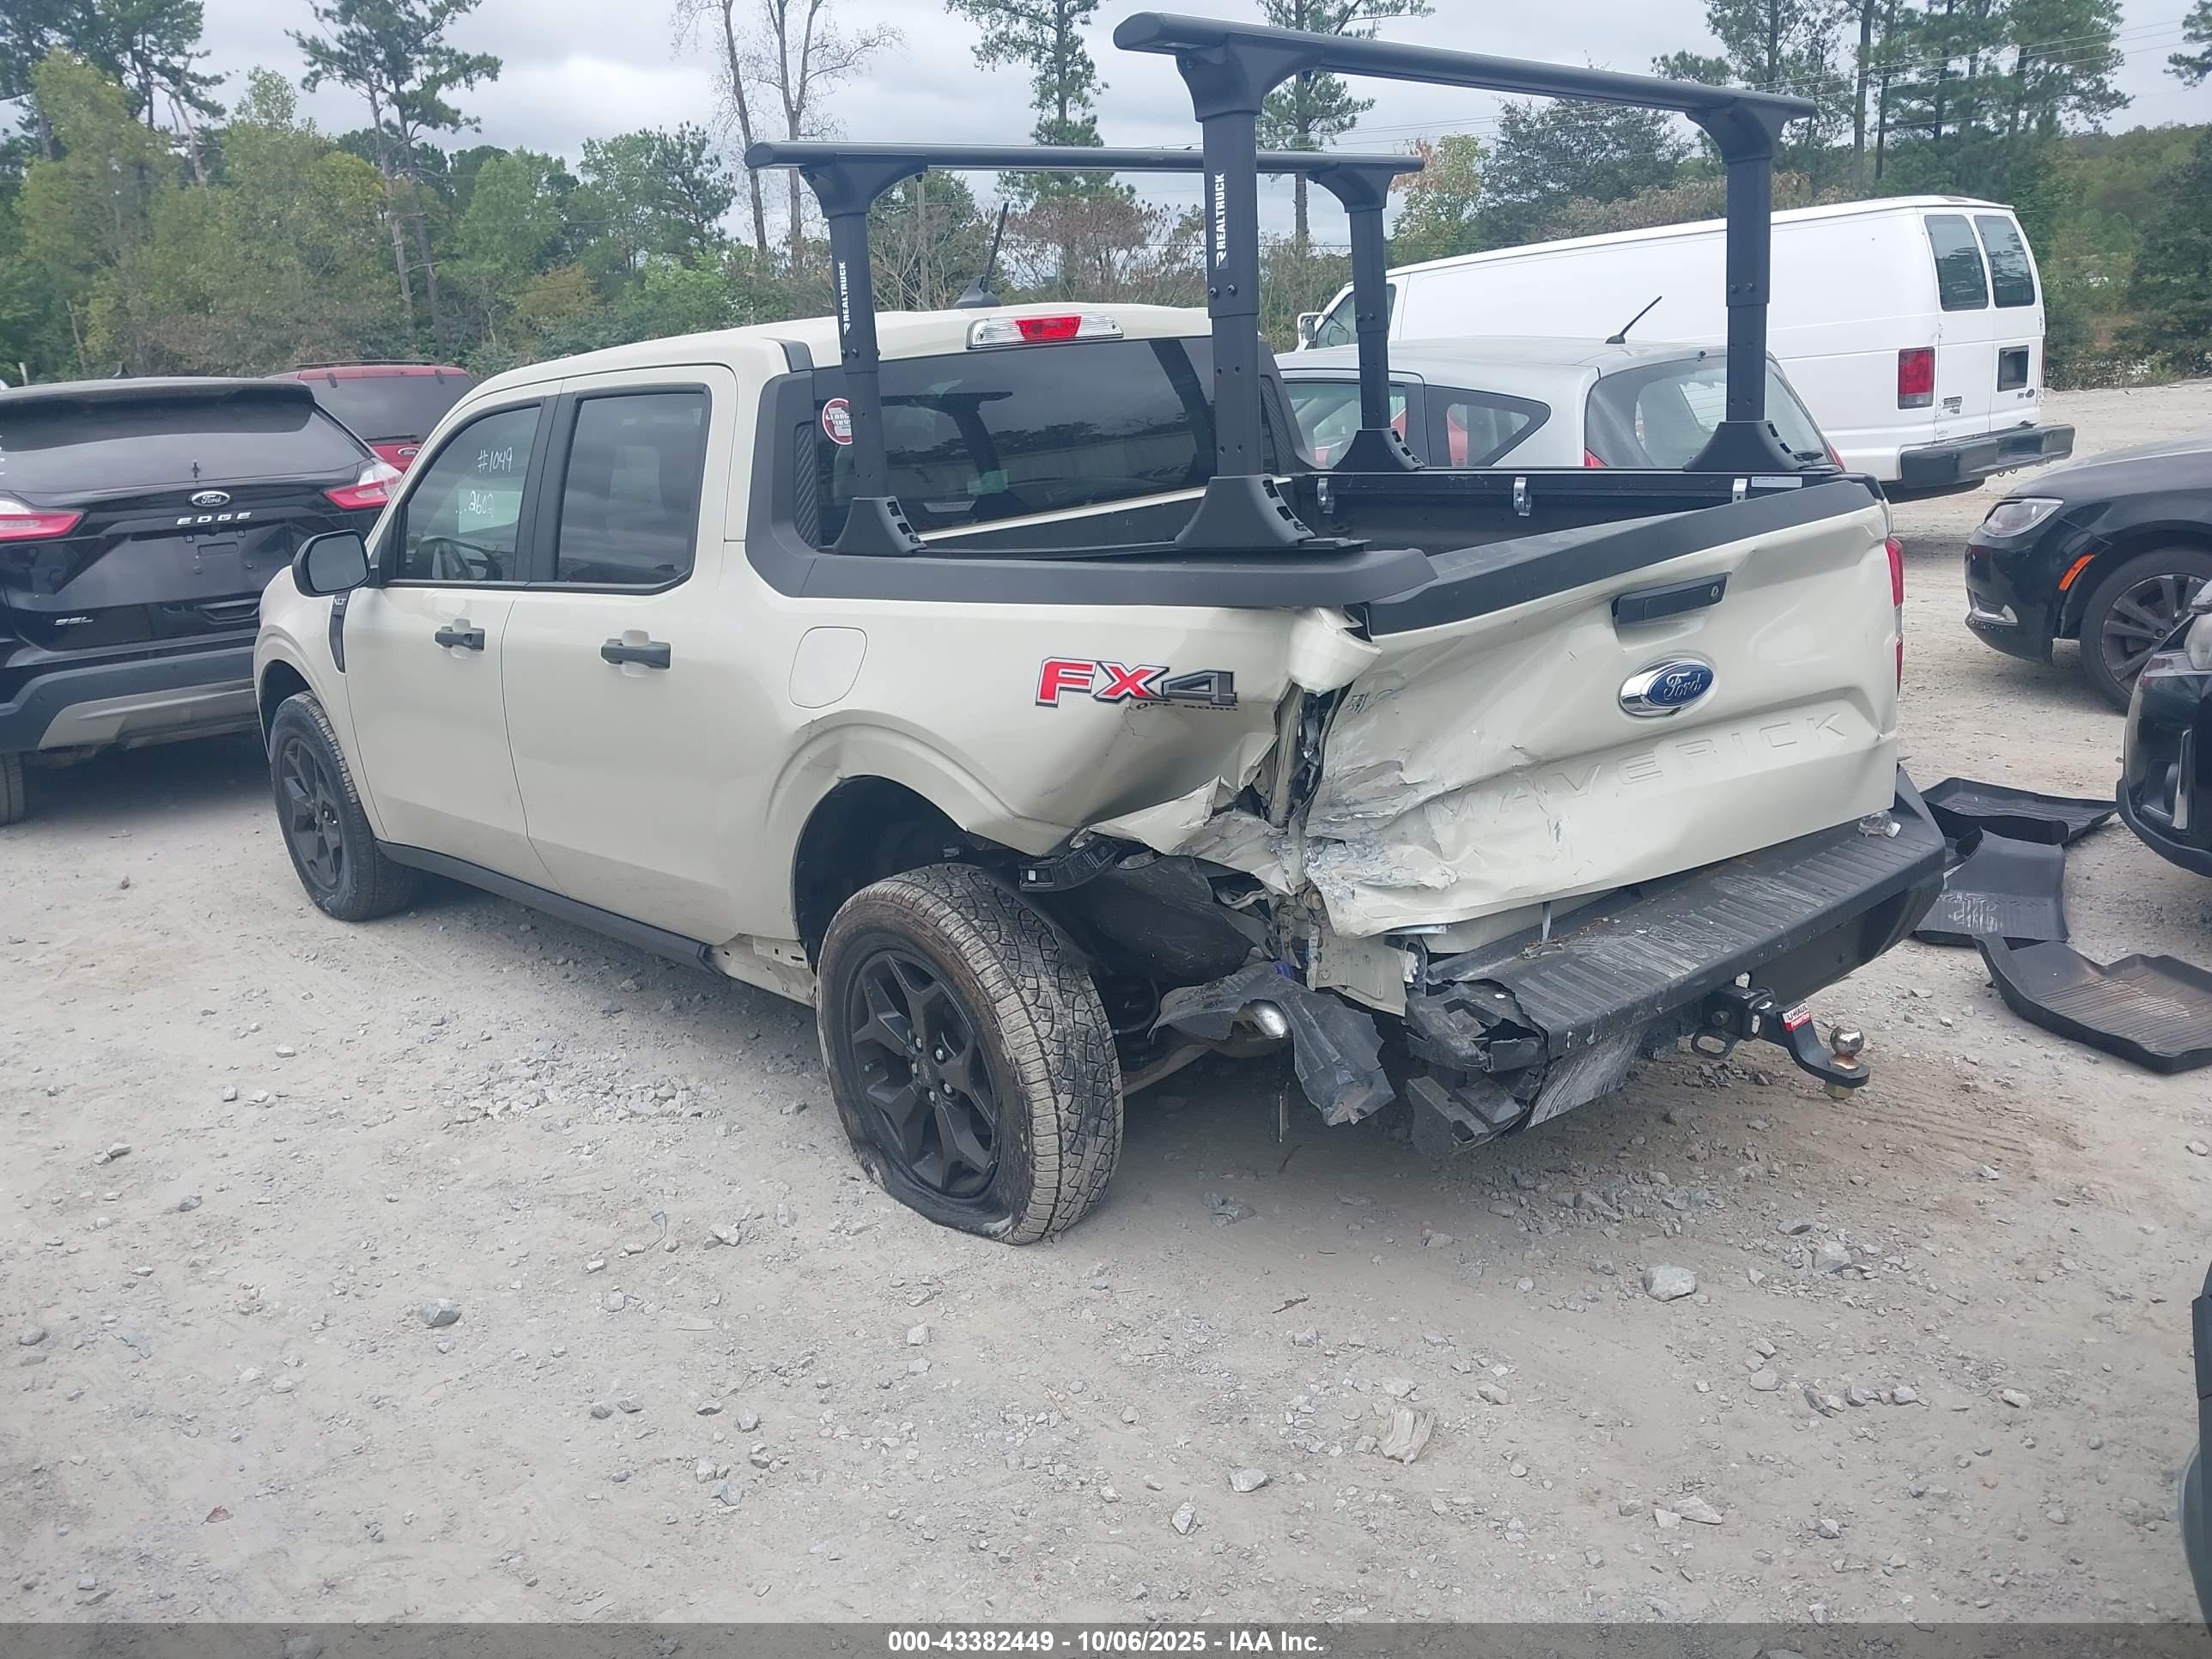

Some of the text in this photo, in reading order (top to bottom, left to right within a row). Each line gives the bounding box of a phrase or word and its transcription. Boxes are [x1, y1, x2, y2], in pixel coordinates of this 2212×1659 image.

[1214, 173, 1226, 250] REALTRUCK
[838, 261, 850, 321] REALTRUCK
[477, 447, 513, 474] #1049
[200, 495, 222, 505] Ford
[177, 512, 252, 526] EDGE
[54, 617, 94, 626] SEL
[1036, 656, 1238, 708] FX4
[1663, 671, 1703, 701] Ford
[1423, 713, 1847, 821] MAVERICK
